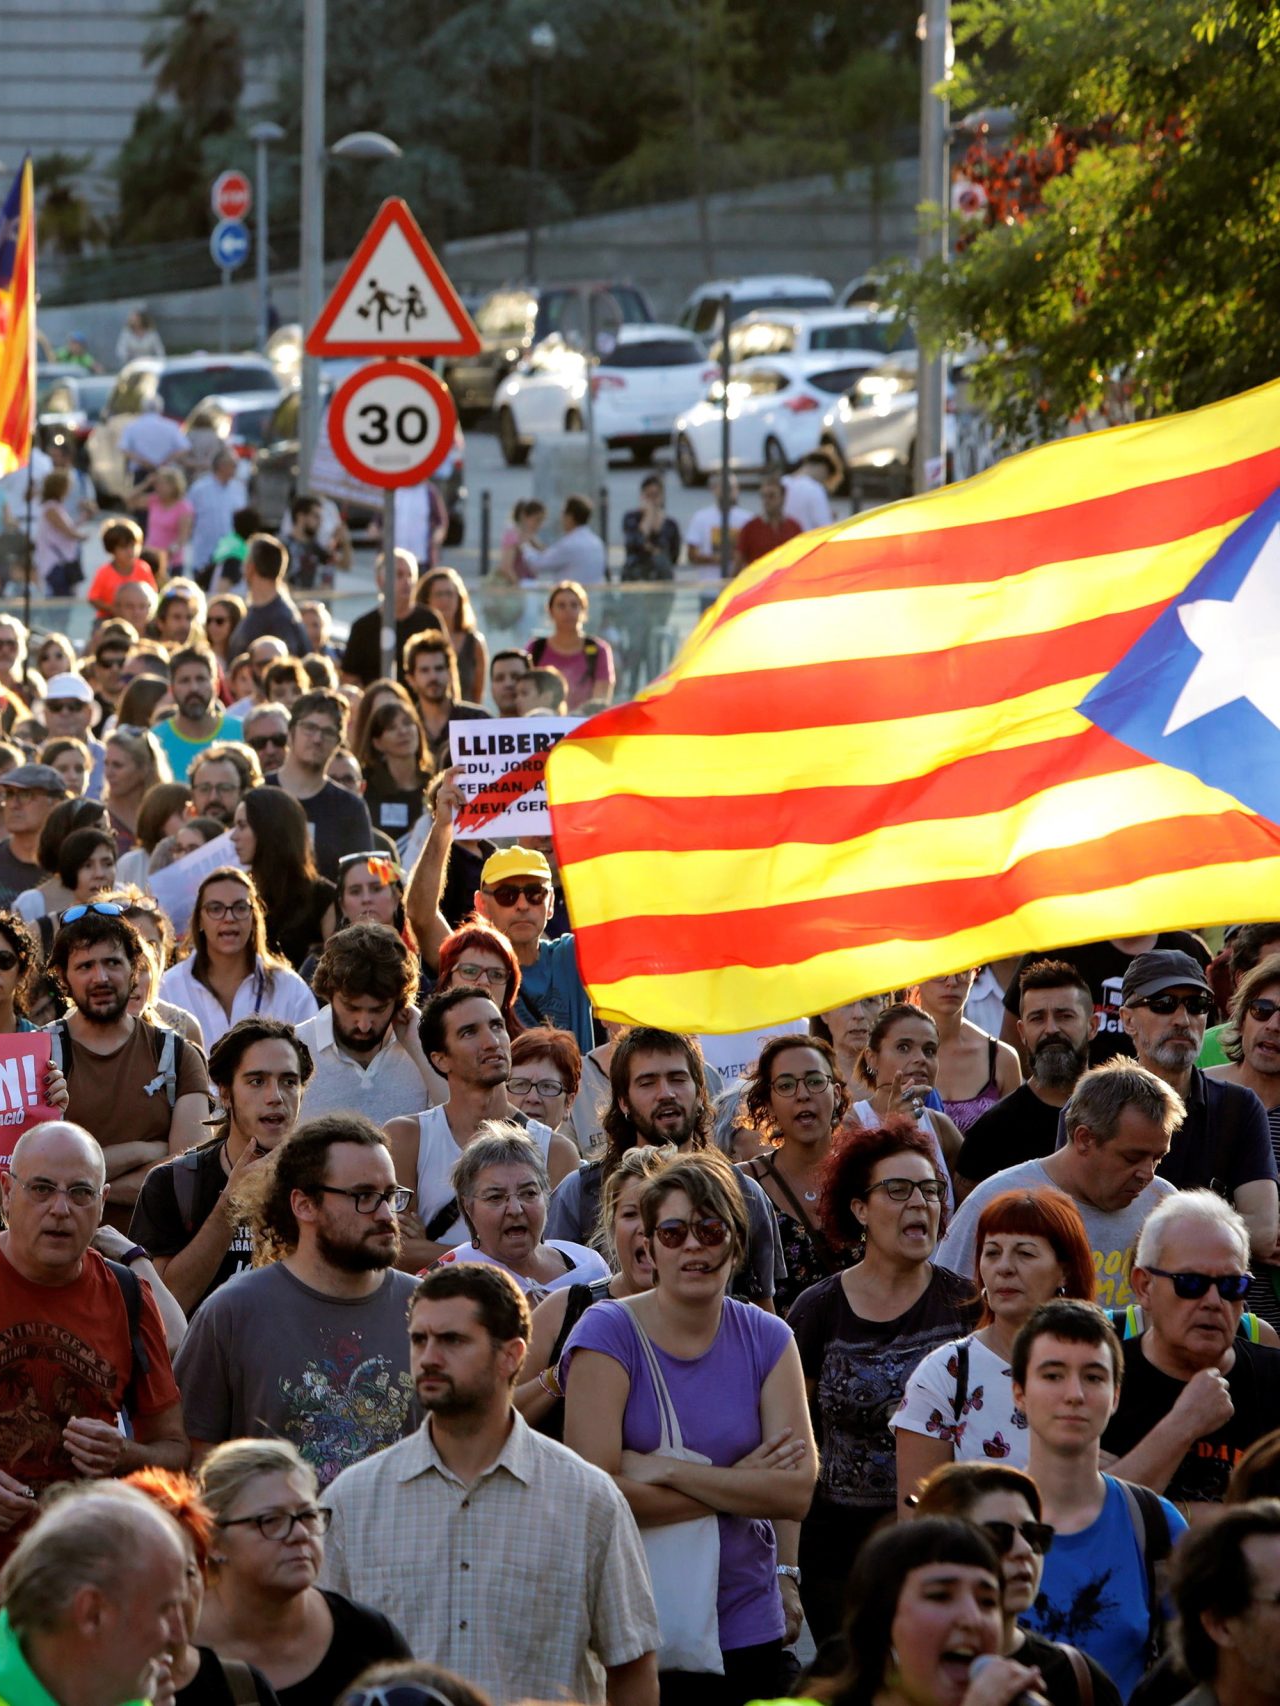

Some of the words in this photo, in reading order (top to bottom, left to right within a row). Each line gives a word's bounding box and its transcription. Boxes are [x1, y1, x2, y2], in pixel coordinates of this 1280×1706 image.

[359, 404, 428, 445] 30
[5, 1322, 81, 1350] VINTAGE
[55, 1347, 110, 1387] COMPANY
